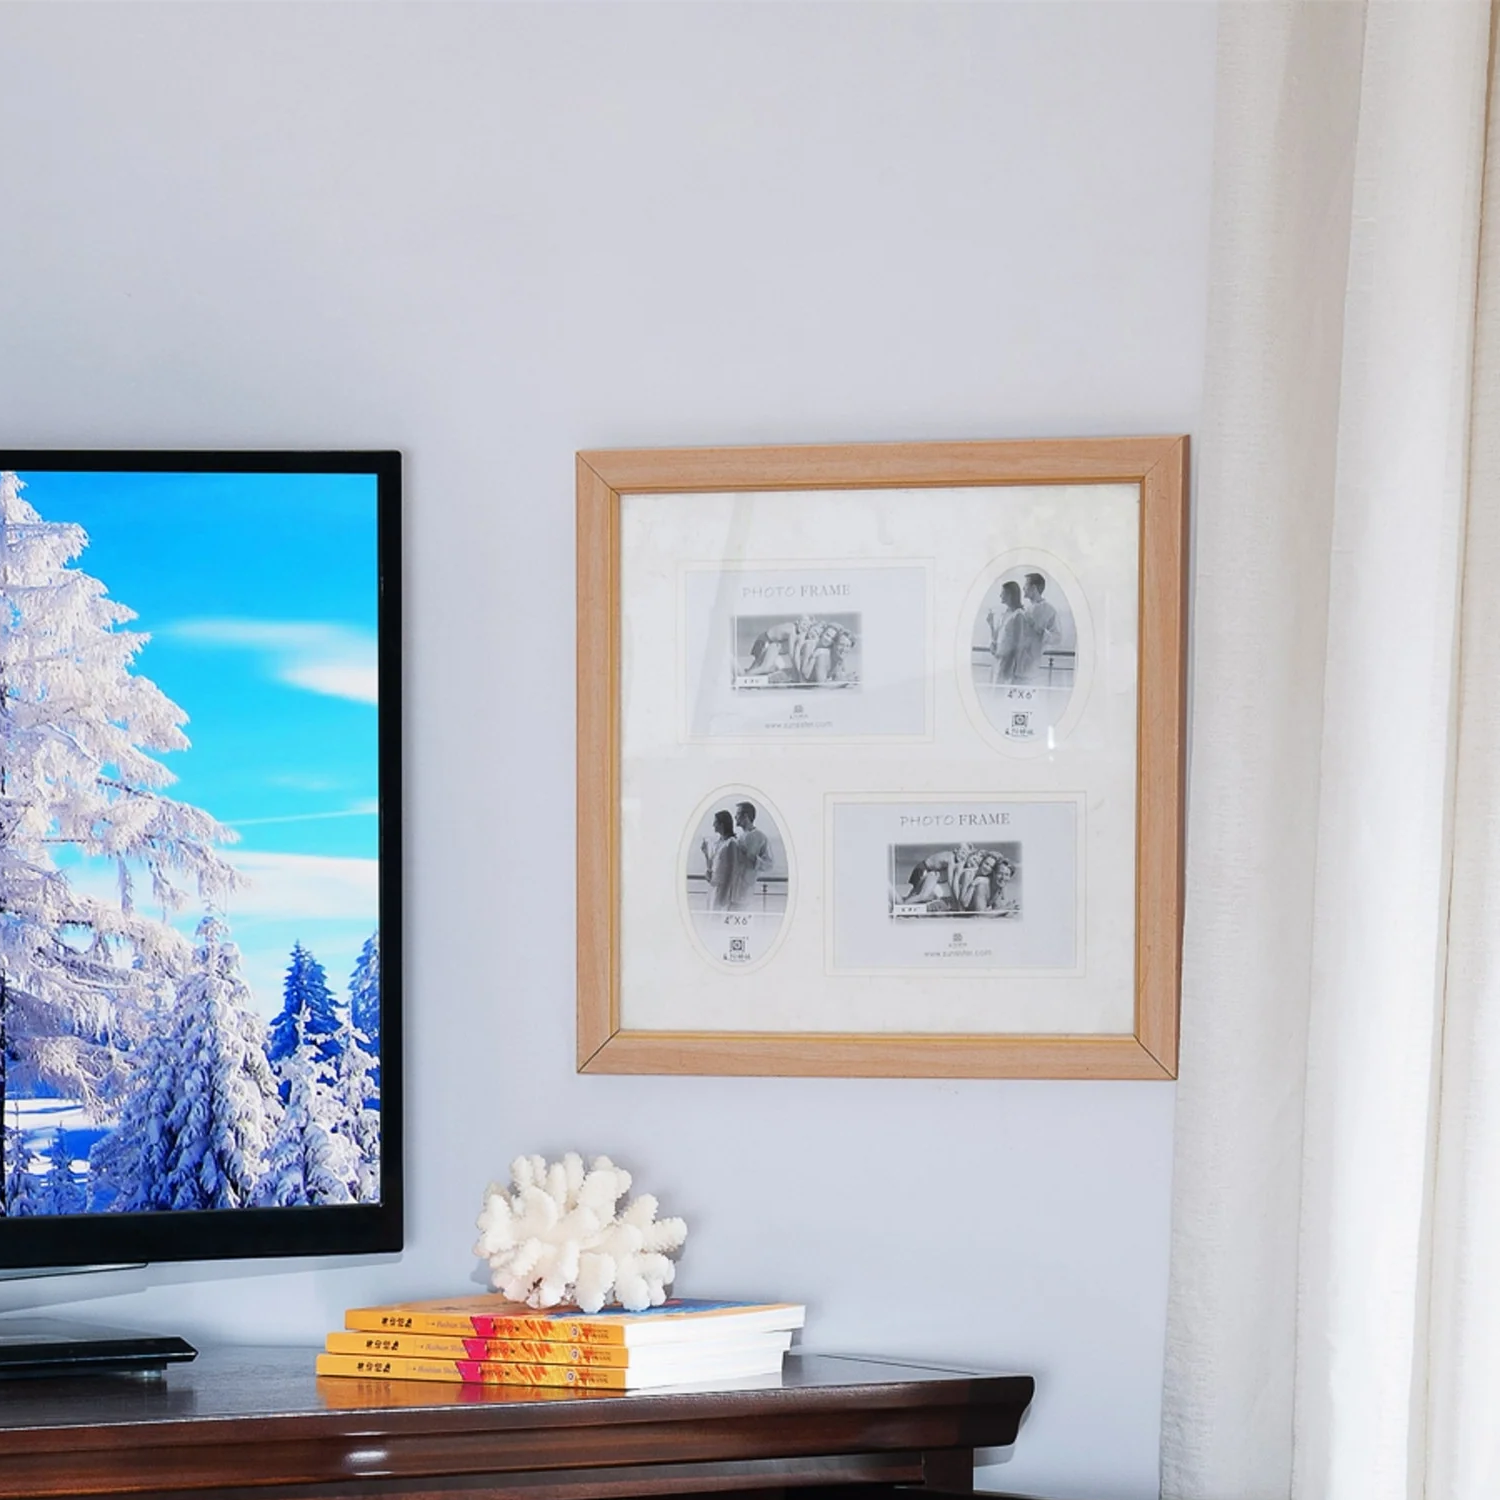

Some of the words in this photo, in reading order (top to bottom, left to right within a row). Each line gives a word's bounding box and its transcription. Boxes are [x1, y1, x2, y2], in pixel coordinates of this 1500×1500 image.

[742, 586, 796, 599] PHOTO
[800, 584, 851, 597] FRAME
[899, 815, 955, 826] PHOTO
[959, 812, 1010, 826] FRAME
